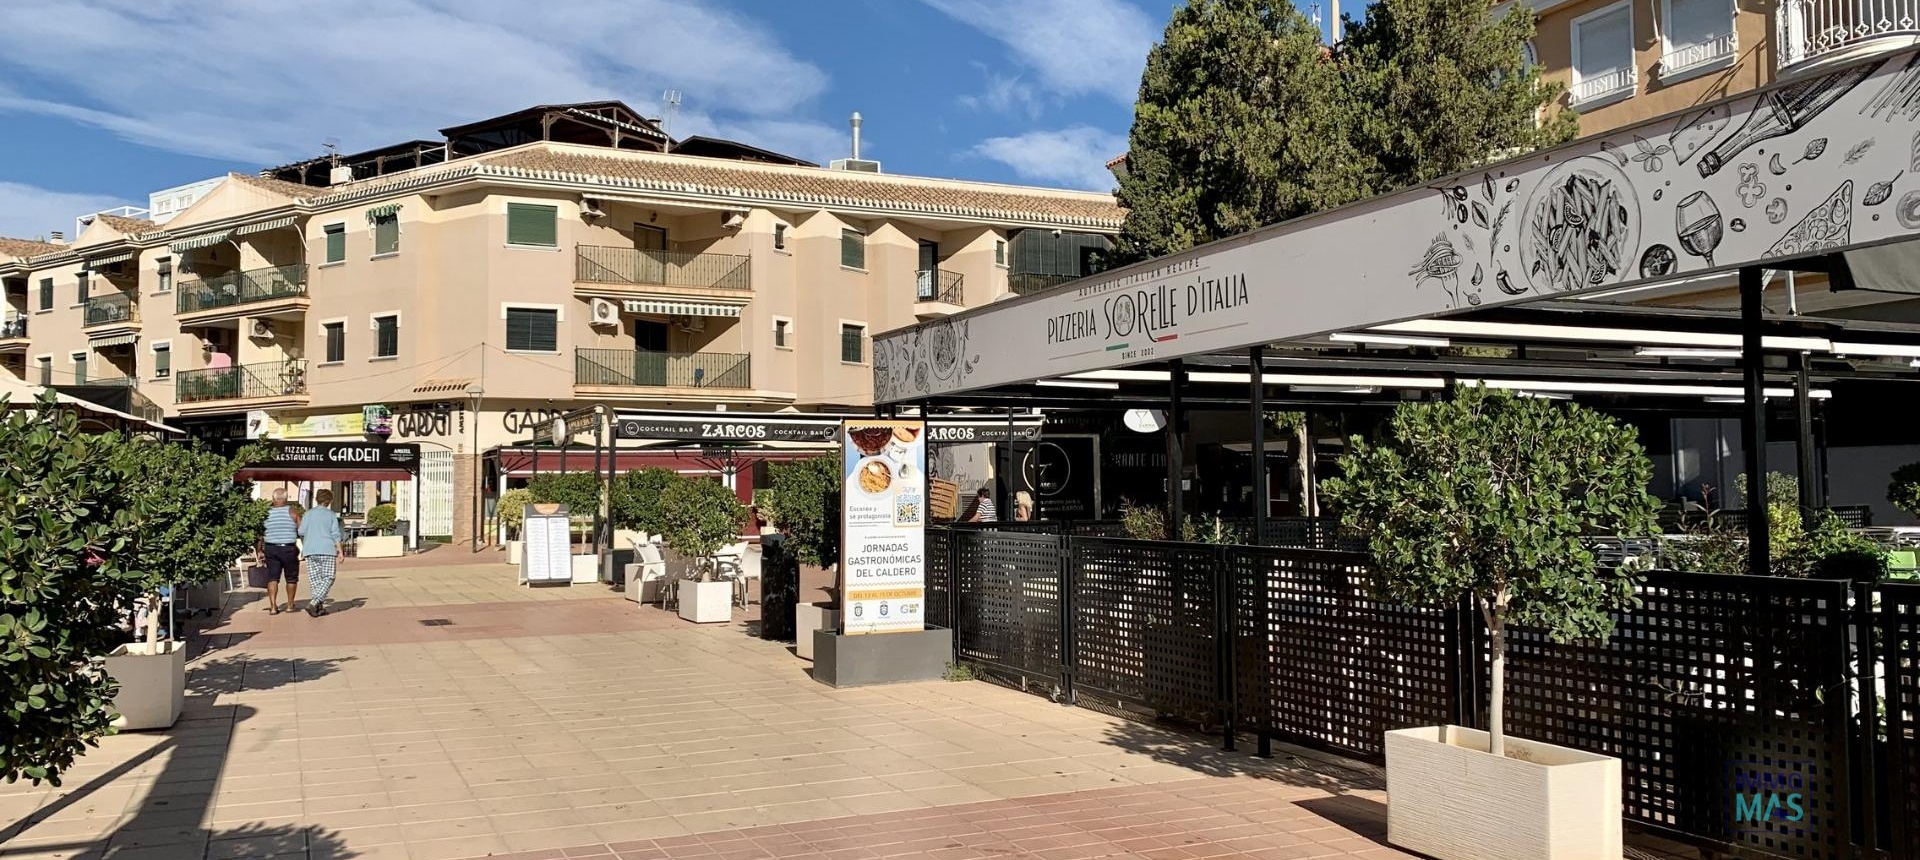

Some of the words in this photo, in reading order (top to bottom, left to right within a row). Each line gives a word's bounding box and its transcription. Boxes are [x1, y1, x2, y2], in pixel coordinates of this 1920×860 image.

[1079, 278, 1121, 296] AUTHENTIC
[1126, 269, 1161, 285] ITALIAN
[1166, 257, 1200, 275] RECIPE
[1047, 308, 1097, 344] PIZZERIA
[1104, 284, 1178, 342] SORELLE
[1187, 272, 1249, 316] D'ITALIA
[1121, 350, 1137, 360] SINCE
[701, 423, 766, 438] ZARCOS
[927, 427, 975, 440] ARCOS
[284, 446, 316, 454] PIZZERIA
[328, 446, 380, 462] GARDEN
[861, 542, 909, 553] JORNADAS
[847, 554, 922, 566] GASTRONÓMICAS
[856, 568, 873, 578] DEL
[875, 567, 917, 577] CALDERO
